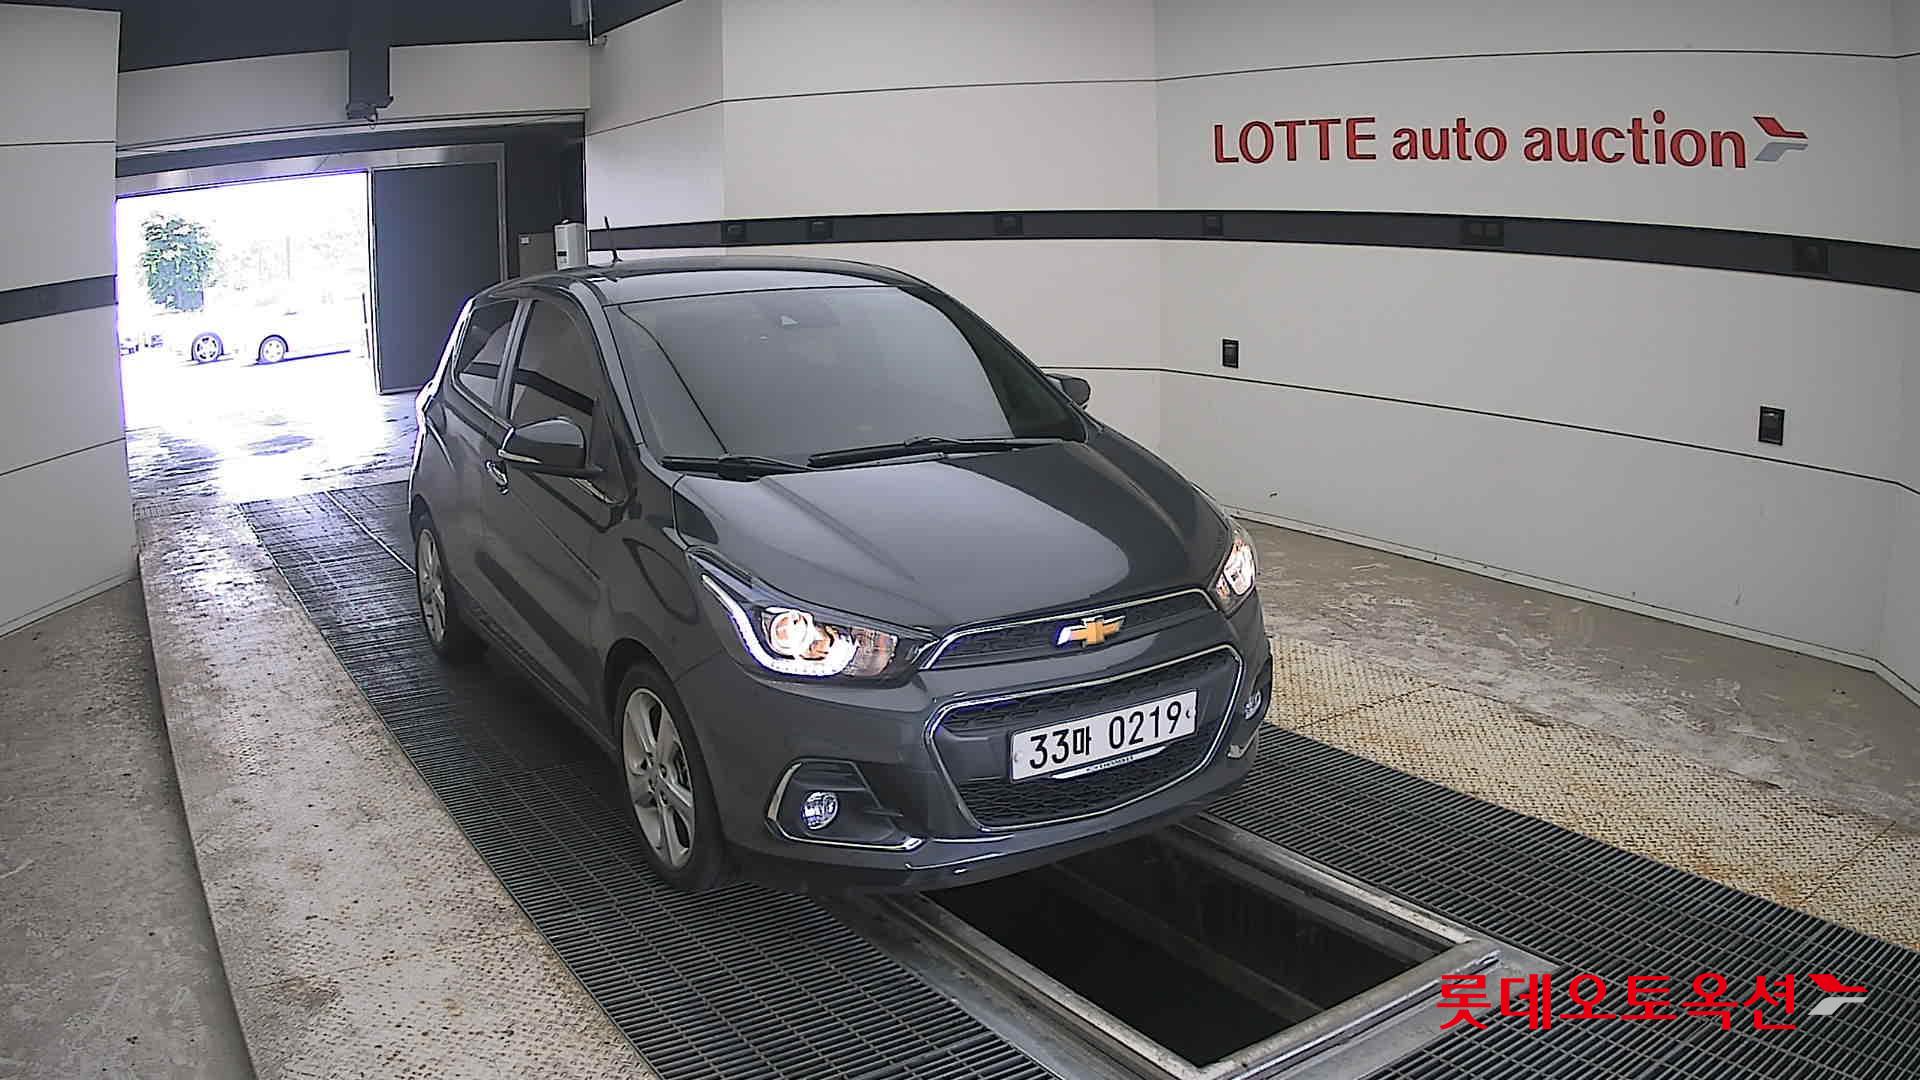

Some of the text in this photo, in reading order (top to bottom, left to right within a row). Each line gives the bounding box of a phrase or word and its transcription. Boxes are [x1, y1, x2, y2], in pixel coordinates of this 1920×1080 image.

[1213, 109, 1747, 168] LOTTE auto auction
[1029, 701, 1182, 769] 33마 0219
